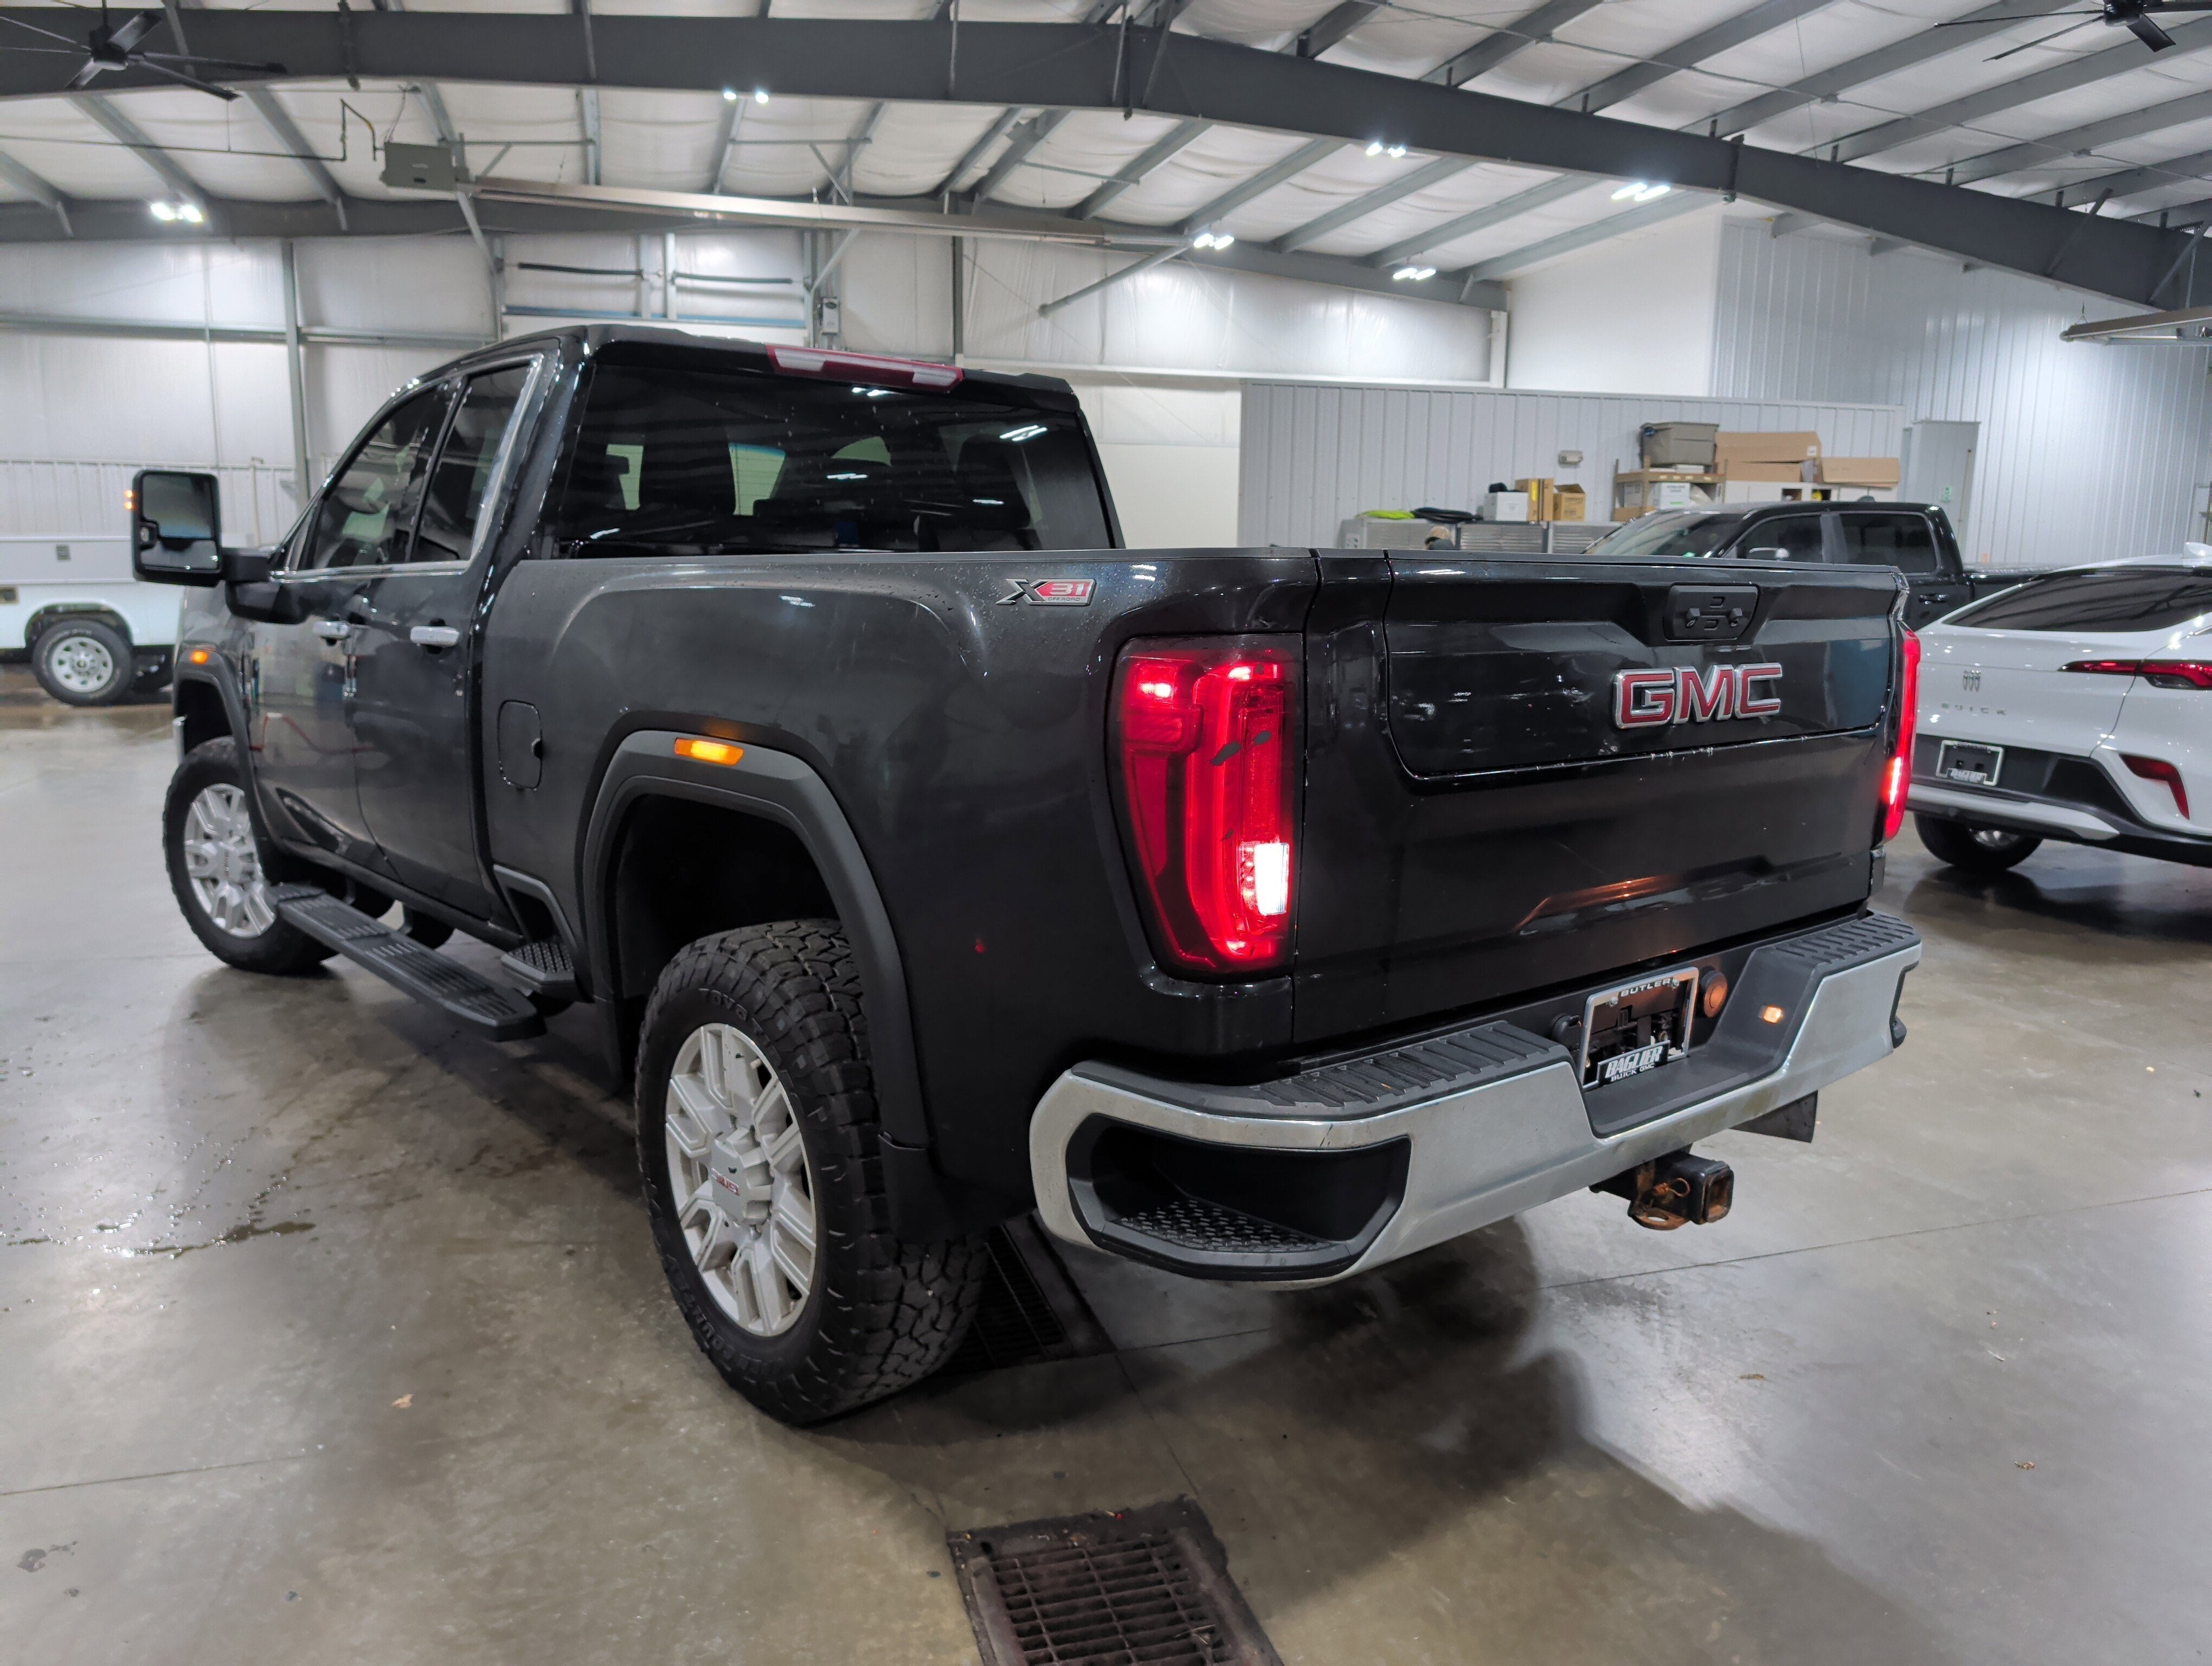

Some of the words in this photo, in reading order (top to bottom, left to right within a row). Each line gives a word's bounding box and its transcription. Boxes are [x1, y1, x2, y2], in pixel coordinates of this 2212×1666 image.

[1613, 662, 1783, 729] GMC
[1620, 977, 1671, 998] BUTLER
[1611, 1069, 1637, 1082] BUICK
[1639, 1062, 1655, 1072] GMC
